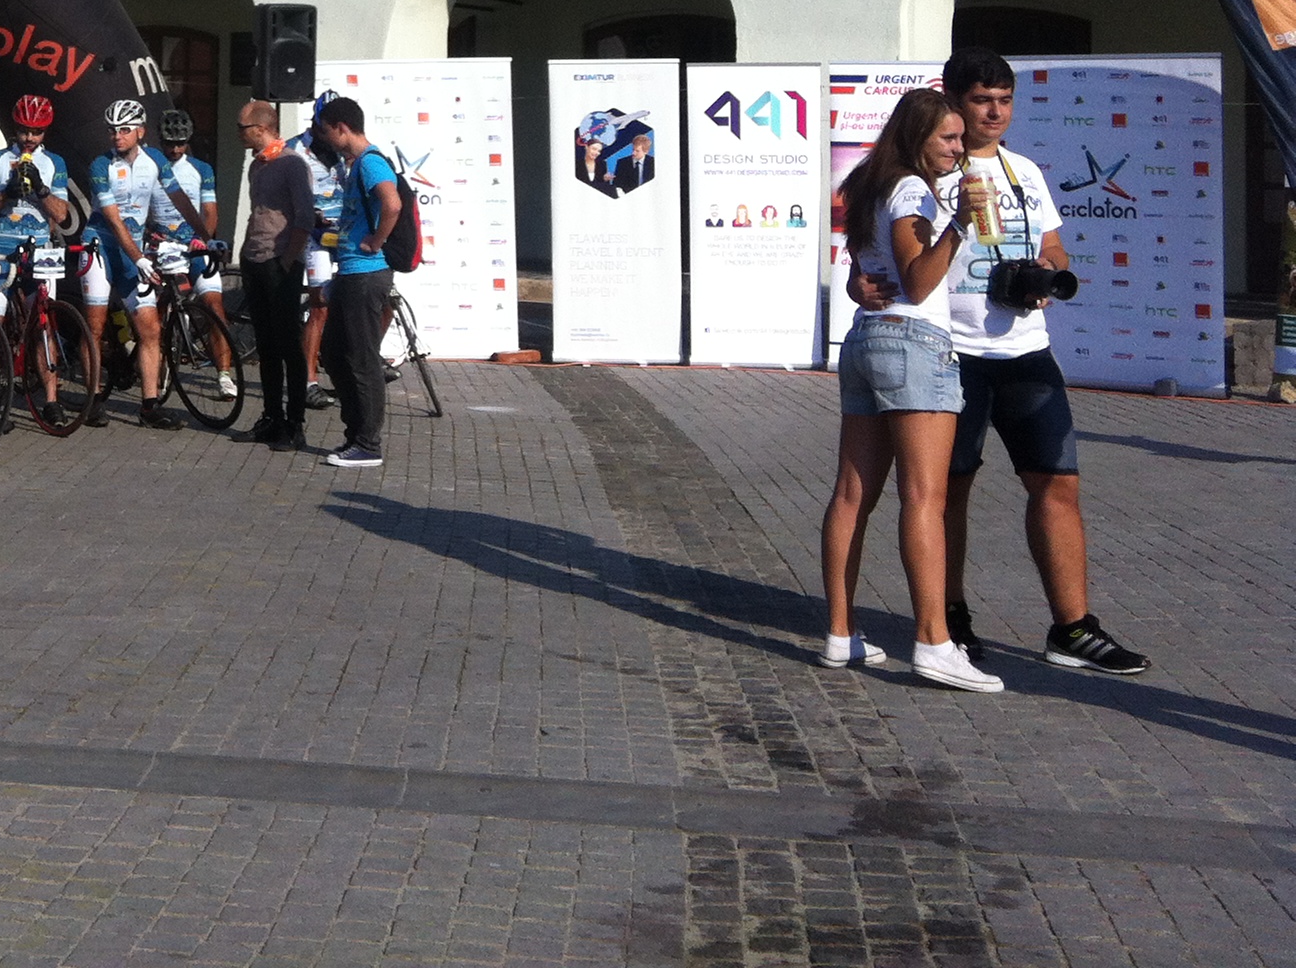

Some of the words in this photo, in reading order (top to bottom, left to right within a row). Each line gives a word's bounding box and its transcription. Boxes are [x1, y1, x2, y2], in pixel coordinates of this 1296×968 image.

[875, 75, 925, 84] URGENT
[704, 90, 807, 141] 441
[843, 111, 878, 122] Urgent
[703, 154, 754, 164] DESIGN
[759, 154, 809, 164] STUDIO
[1060, 197, 1137, 219] ciclaton
